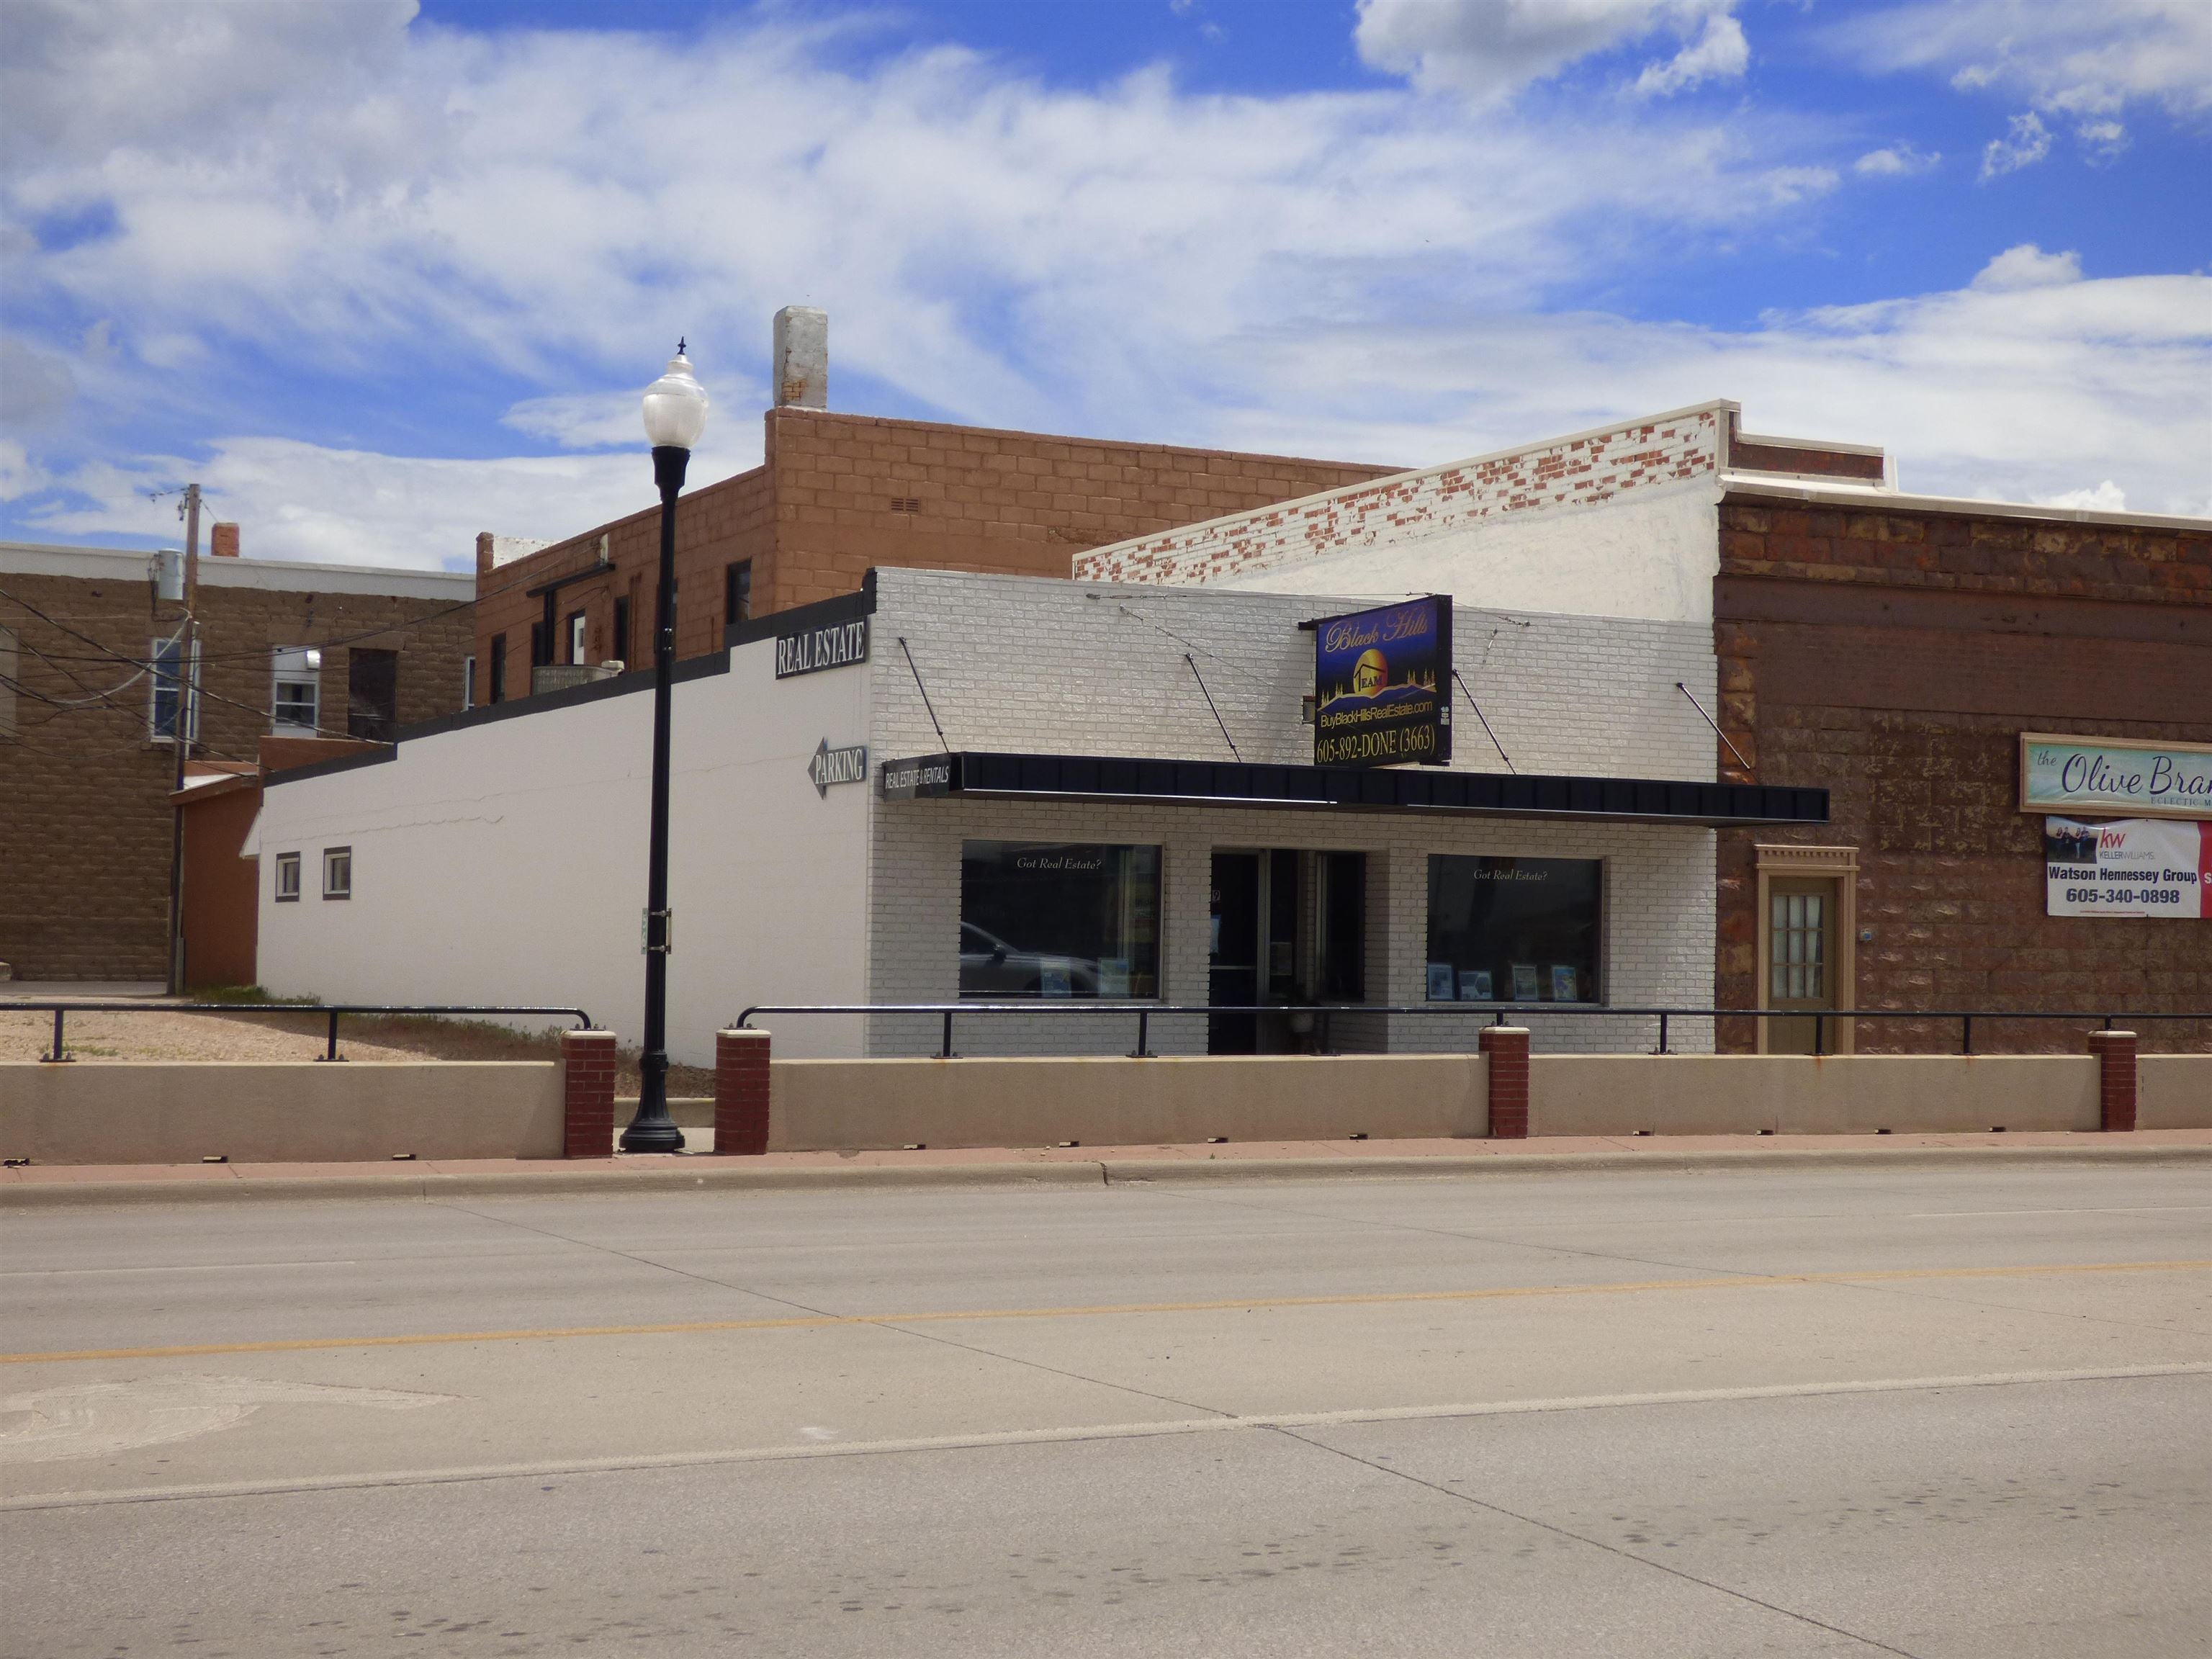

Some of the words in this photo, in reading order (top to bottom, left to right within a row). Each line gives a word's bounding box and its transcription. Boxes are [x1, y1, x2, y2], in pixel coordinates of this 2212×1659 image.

[1325, 619, 1378, 652] Black
[1382, 607, 1429, 642] Hills
[778, 634, 811, 675] REAL
[814, 621, 864, 667] ESTATE
[1321, 700, 1433, 729] BuyBlackHillsRealEstate.com
[1317, 730, 1396, 763] 605-892-DONE
[1400, 724, 1435, 757] (3663)
[814, 748, 863, 785] PARKING
[885, 772, 899, 789] REAL
[900, 769, 920, 788] ESTATE
[923, 765, 950, 785] RENTALS
[2037, 750, 2057, 766] the
[2061, 753, 2143, 794] Olive
[2151, 797, 2199, 806] ECLECTIC
[2100, 827, 2126, 848] kw
[1017, 857, 1037, 869] Got
[1040, 856, 1062, 869] Real
[1065, 858, 1102, 870] Estate?
[1473, 869, 1491, 880] Got
[1493, 868, 1514, 880] Real
[1515, 870, 1547, 881] Estate?
[2049, 866, 2096, 881] Watson
[2100, 868, 2159, 884] Hennessey
[2163, 868, 2198, 885] Group
[2066, 889, 2180, 904] 605-340-0898
